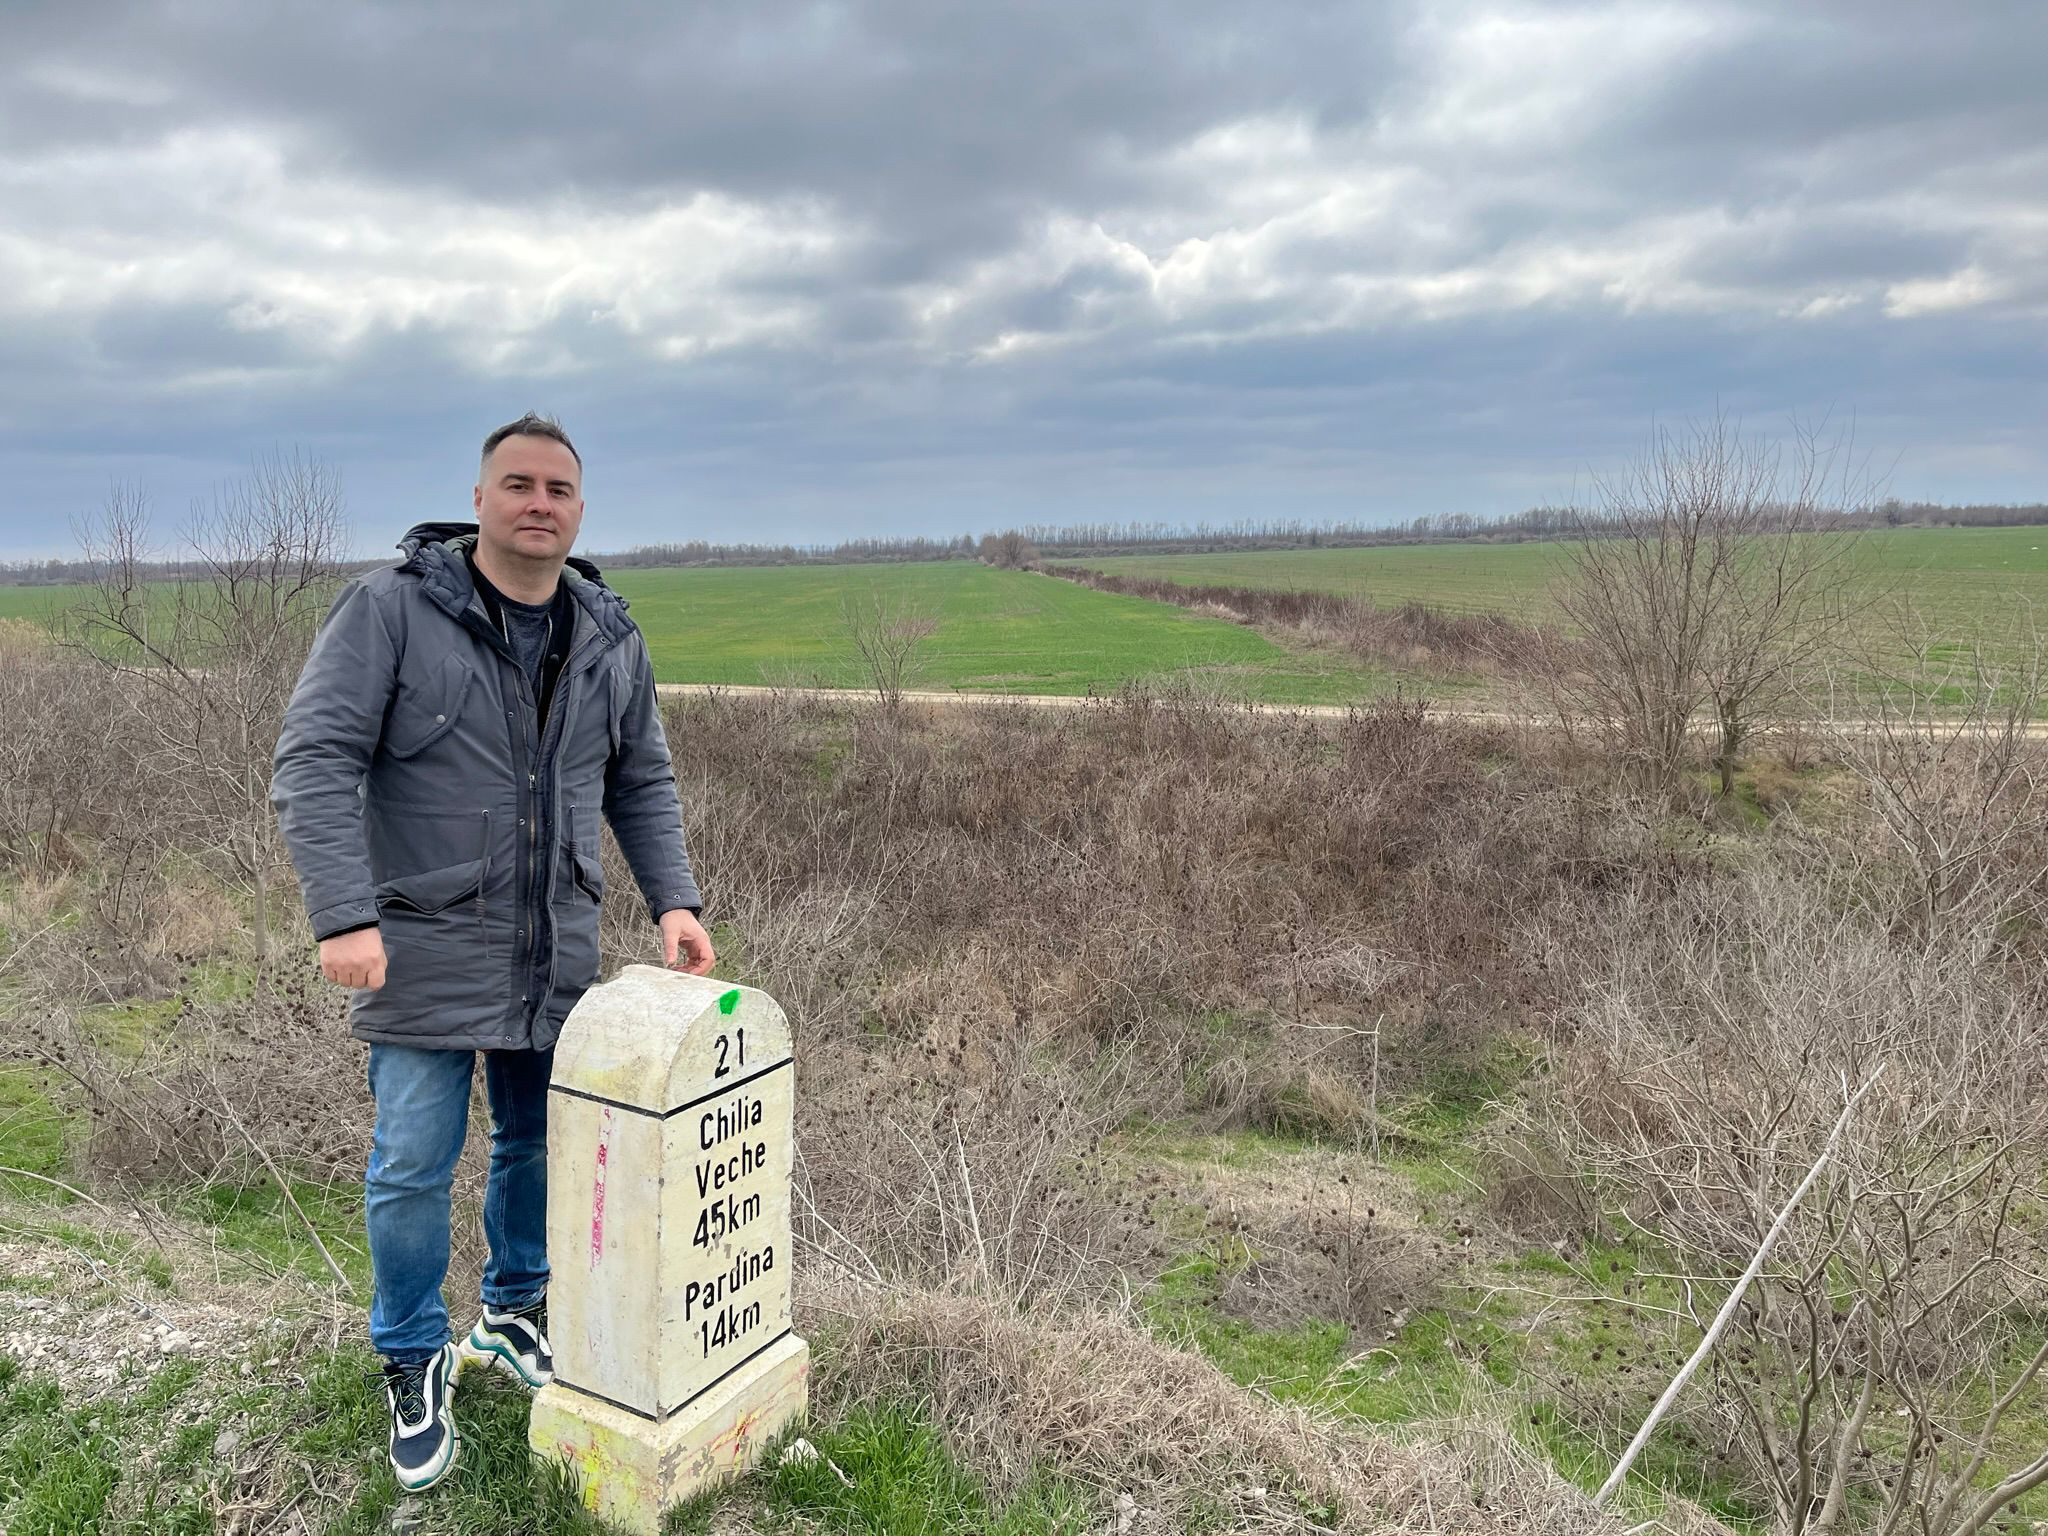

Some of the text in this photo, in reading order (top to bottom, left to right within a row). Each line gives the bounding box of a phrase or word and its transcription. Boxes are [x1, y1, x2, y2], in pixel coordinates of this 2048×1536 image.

[714, 1028, 744, 1079] 21
[700, 1096, 762, 1151] Chilia
[696, 1141, 766, 1199] Veche
[693, 1193, 760, 1249] 45km
[685, 1245, 773, 1321] Pardina
[701, 1301, 760, 1359] 14km
